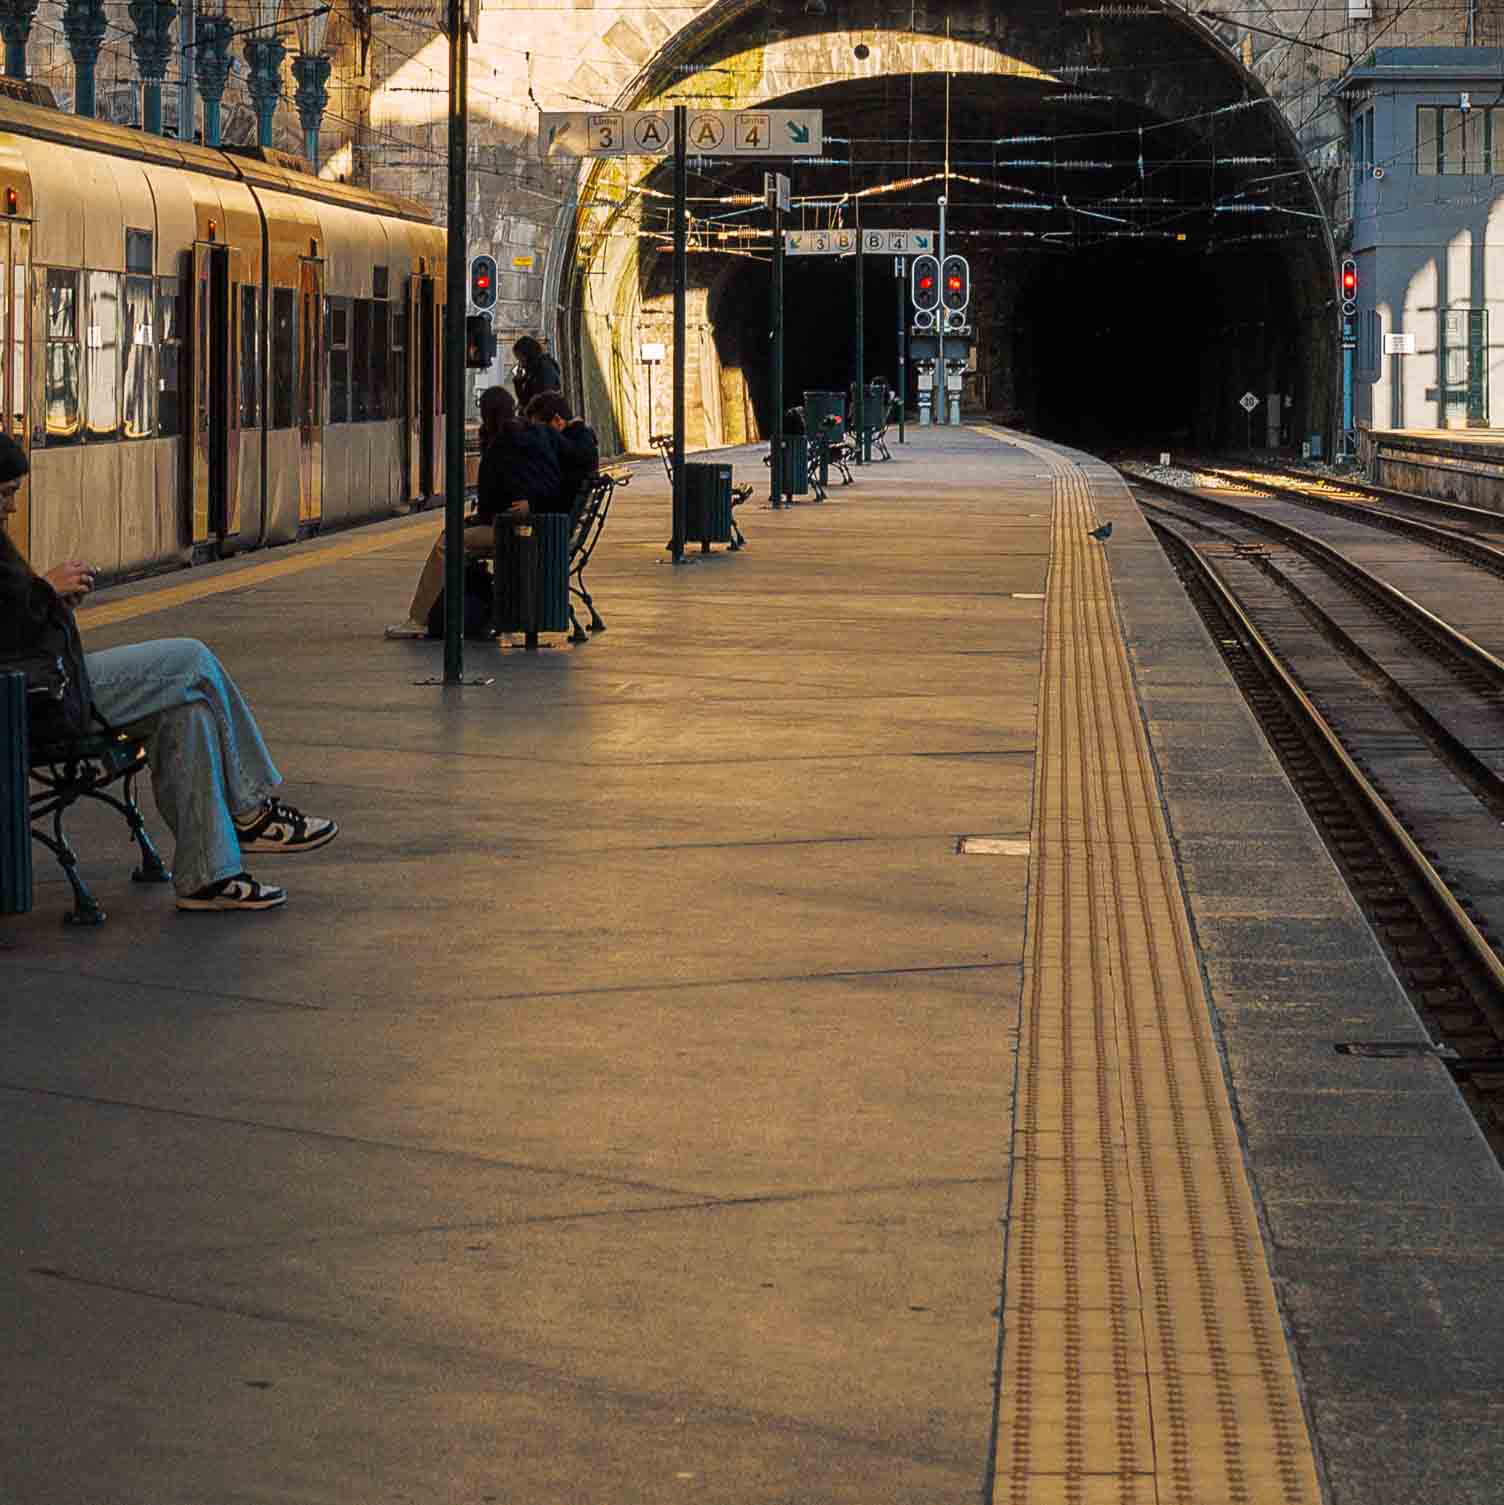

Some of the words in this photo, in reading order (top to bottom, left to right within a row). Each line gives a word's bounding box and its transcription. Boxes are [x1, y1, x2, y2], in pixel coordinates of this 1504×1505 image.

[600, 127, 613, 148] 3
[642, 122, 662, 144] A
[696, 122, 717, 144] A
[745, 126, 761, 147] 4
[816, 238, 825, 250] 3
[839, 235, 849, 248] B
[869, 235, 880, 248] B
[894, 238, 903, 249] 4
